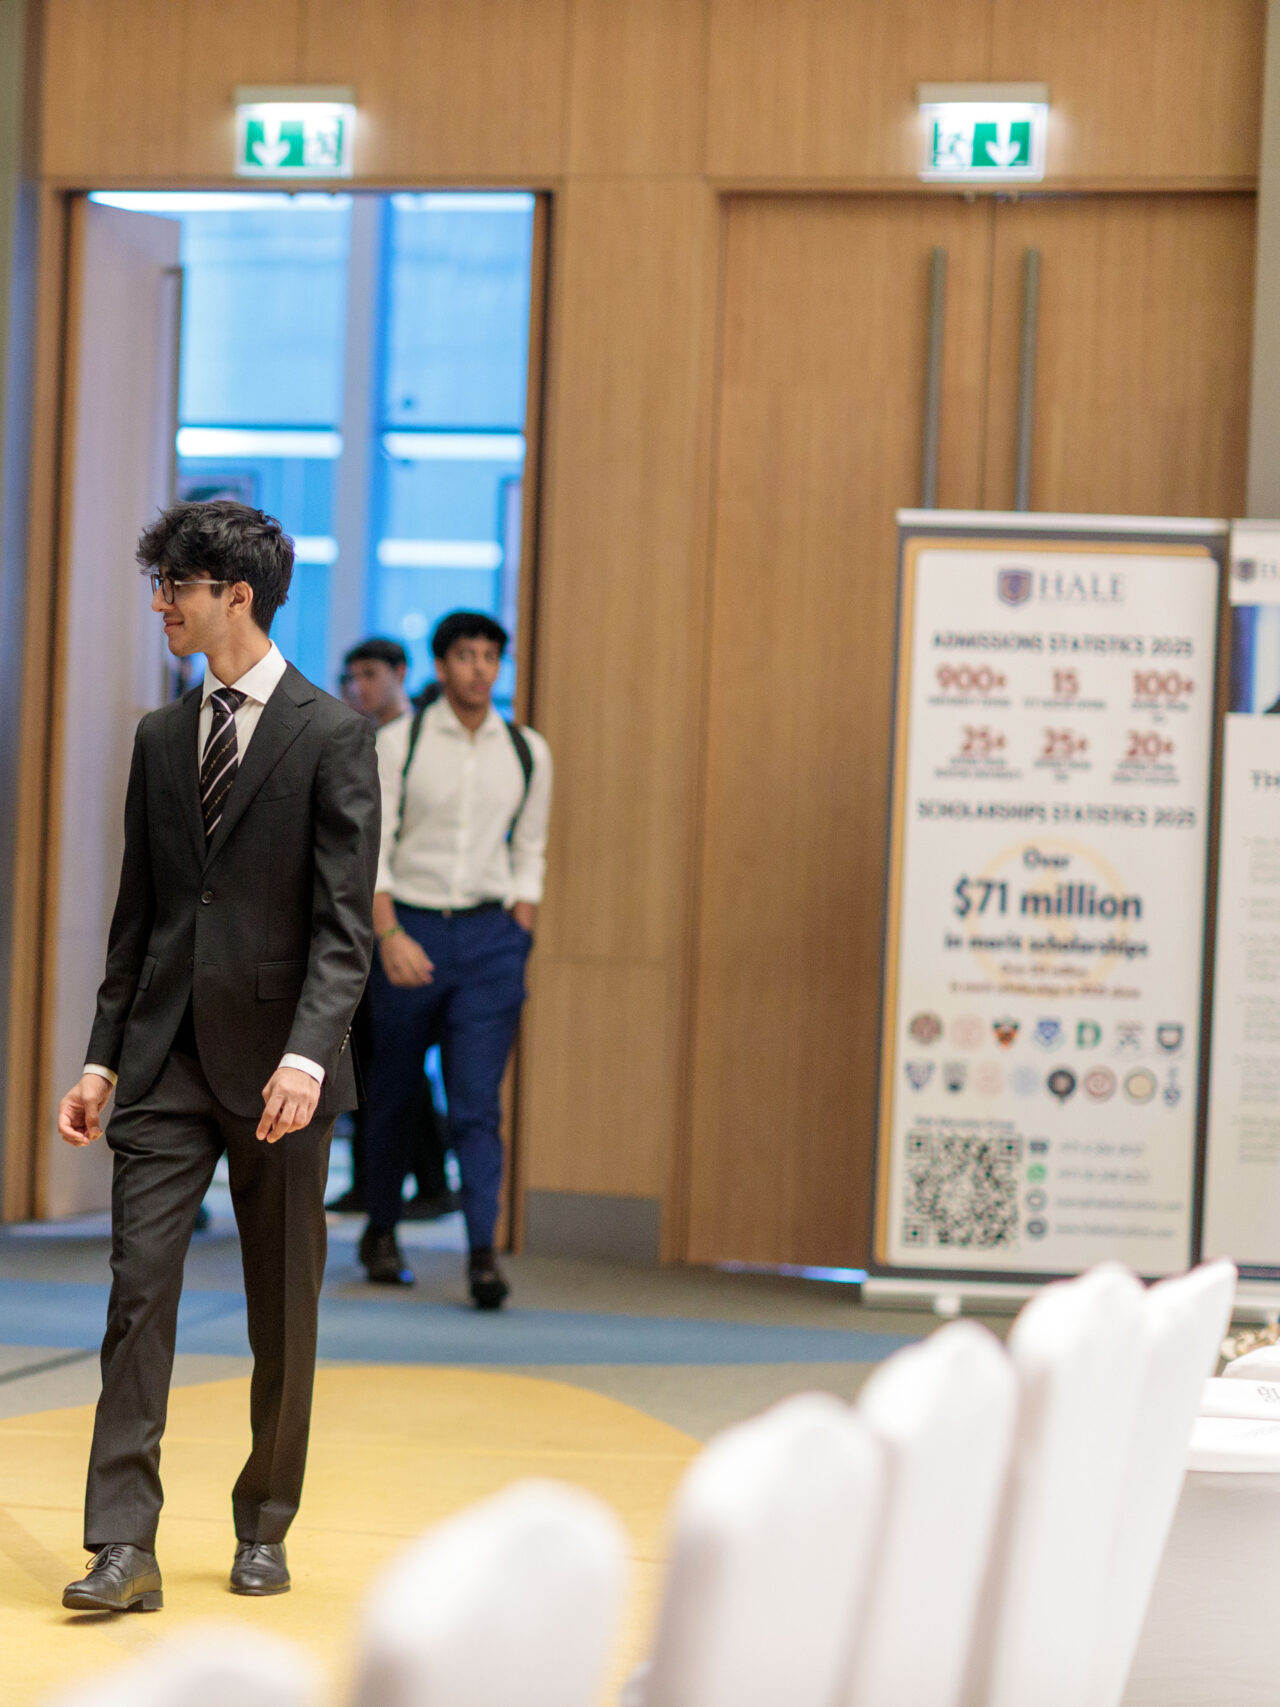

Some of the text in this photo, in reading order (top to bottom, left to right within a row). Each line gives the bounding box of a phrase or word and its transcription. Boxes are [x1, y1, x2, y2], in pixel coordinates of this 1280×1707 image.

[1040, 571, 1124, 600] HALE
[933, 630, 1194, 656] ADMISSIONS STATISTICS 2025
[936, 664, 1006, 690] 900+
[1052, 667, 1079, 695] 15
[1132, 669, 1194, 697] 100+
[962, 725, 1006, 755] 25+
[1043, 727, 1088, 757] 25+
[1126, 730, 1175, 758] 20+
[918, 800, 1046, 822] SCHOLARSHIPS
[1052, 803, 1147, 826] STATISTICS
[1022, 847, 1070, 868] Over
[954, 874, 1142, 918] $71 million
[969, 932, 1022, 950] merit
[1029, 933, 1148, 960] scholarships
